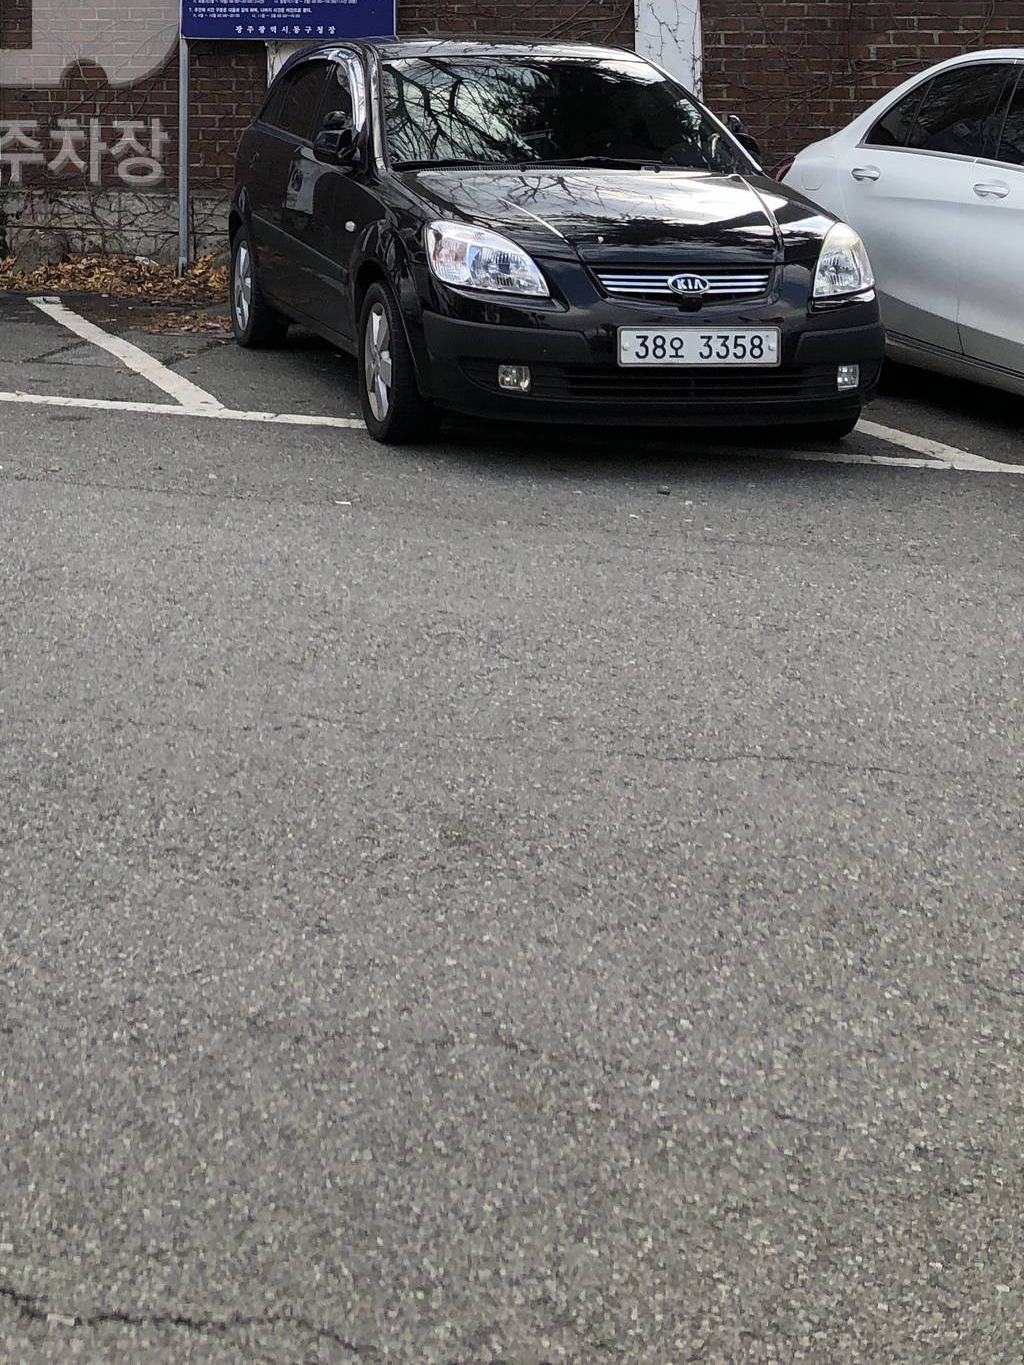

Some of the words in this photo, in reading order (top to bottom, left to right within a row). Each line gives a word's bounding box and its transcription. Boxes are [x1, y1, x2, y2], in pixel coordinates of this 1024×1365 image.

[676, 279, 704, 290] KIA
[634, 335, 685, 359] 38오
[698, 335, 764, 359] 3358
